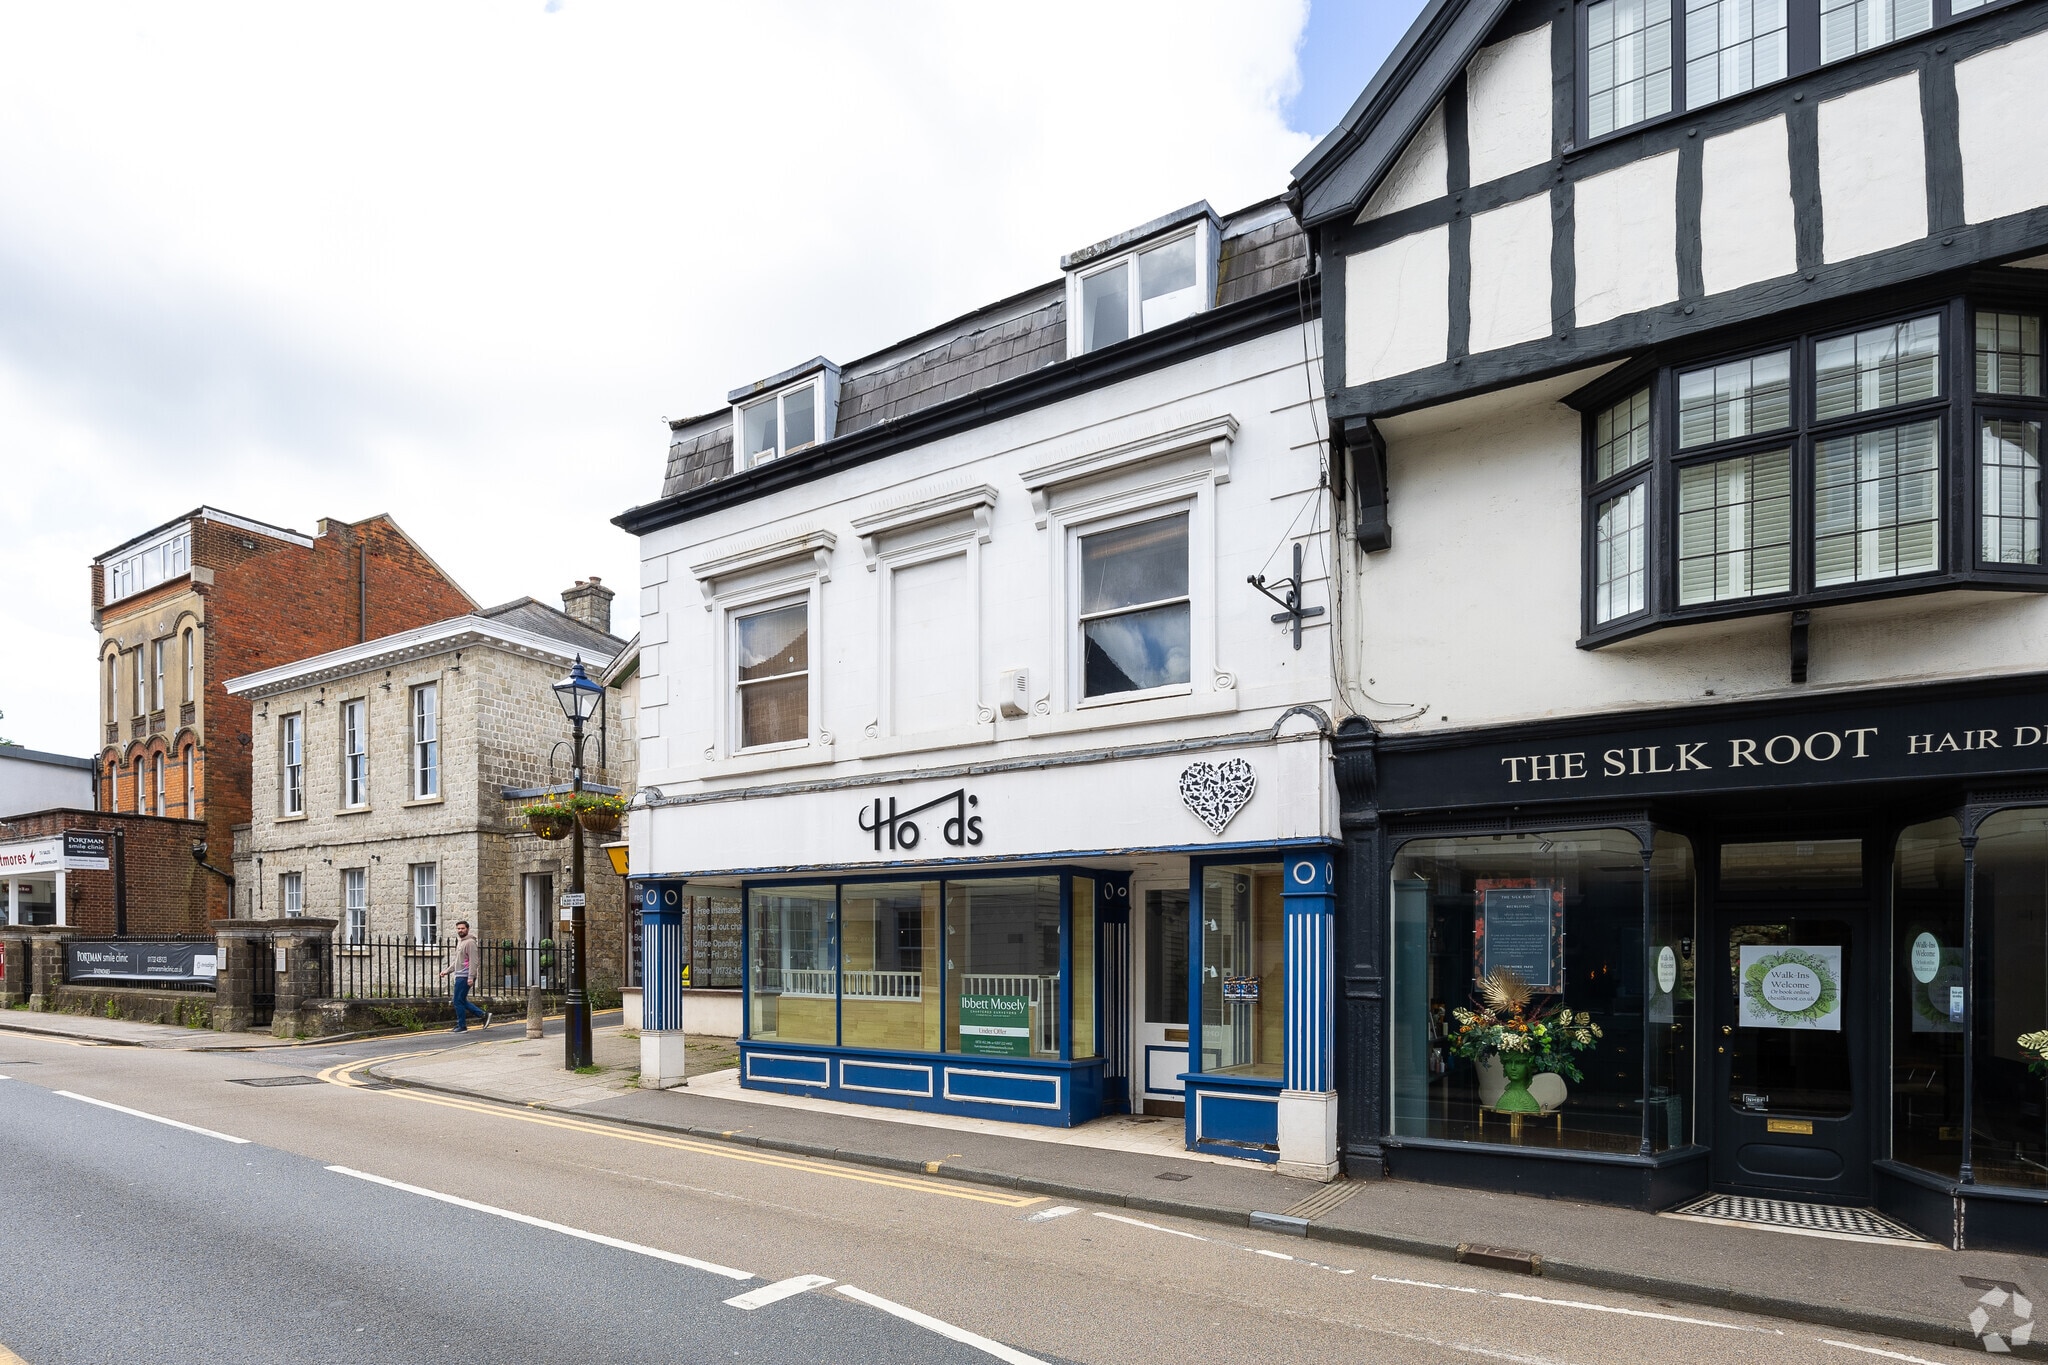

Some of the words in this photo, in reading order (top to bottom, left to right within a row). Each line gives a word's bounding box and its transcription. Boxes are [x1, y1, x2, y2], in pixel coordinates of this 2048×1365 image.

[1501, 752, 1588, 783] THE
[1603, 742, 1712, 777] SILK
[1728, 727, 1878, 767] ROOT
[1907, 729, 2002, 754] HAIR
[713, 940, 738, 948] Opening
[1915, 941, 1936, 949] Walk-Ins
[77, 951, 102, 963] PORTMAN
[102, 952, 115, 962] smile
[116, 952, 129, 963] clinic
[693, 967, 712, 975] Phone
[1771, 971, 1810, 979] Walk-Ins
[1771, 981, 1810, 989] Welcome
[961, 997, 989, 1009] Ibbett
[990, 998, 1026, 1014] Mosely
